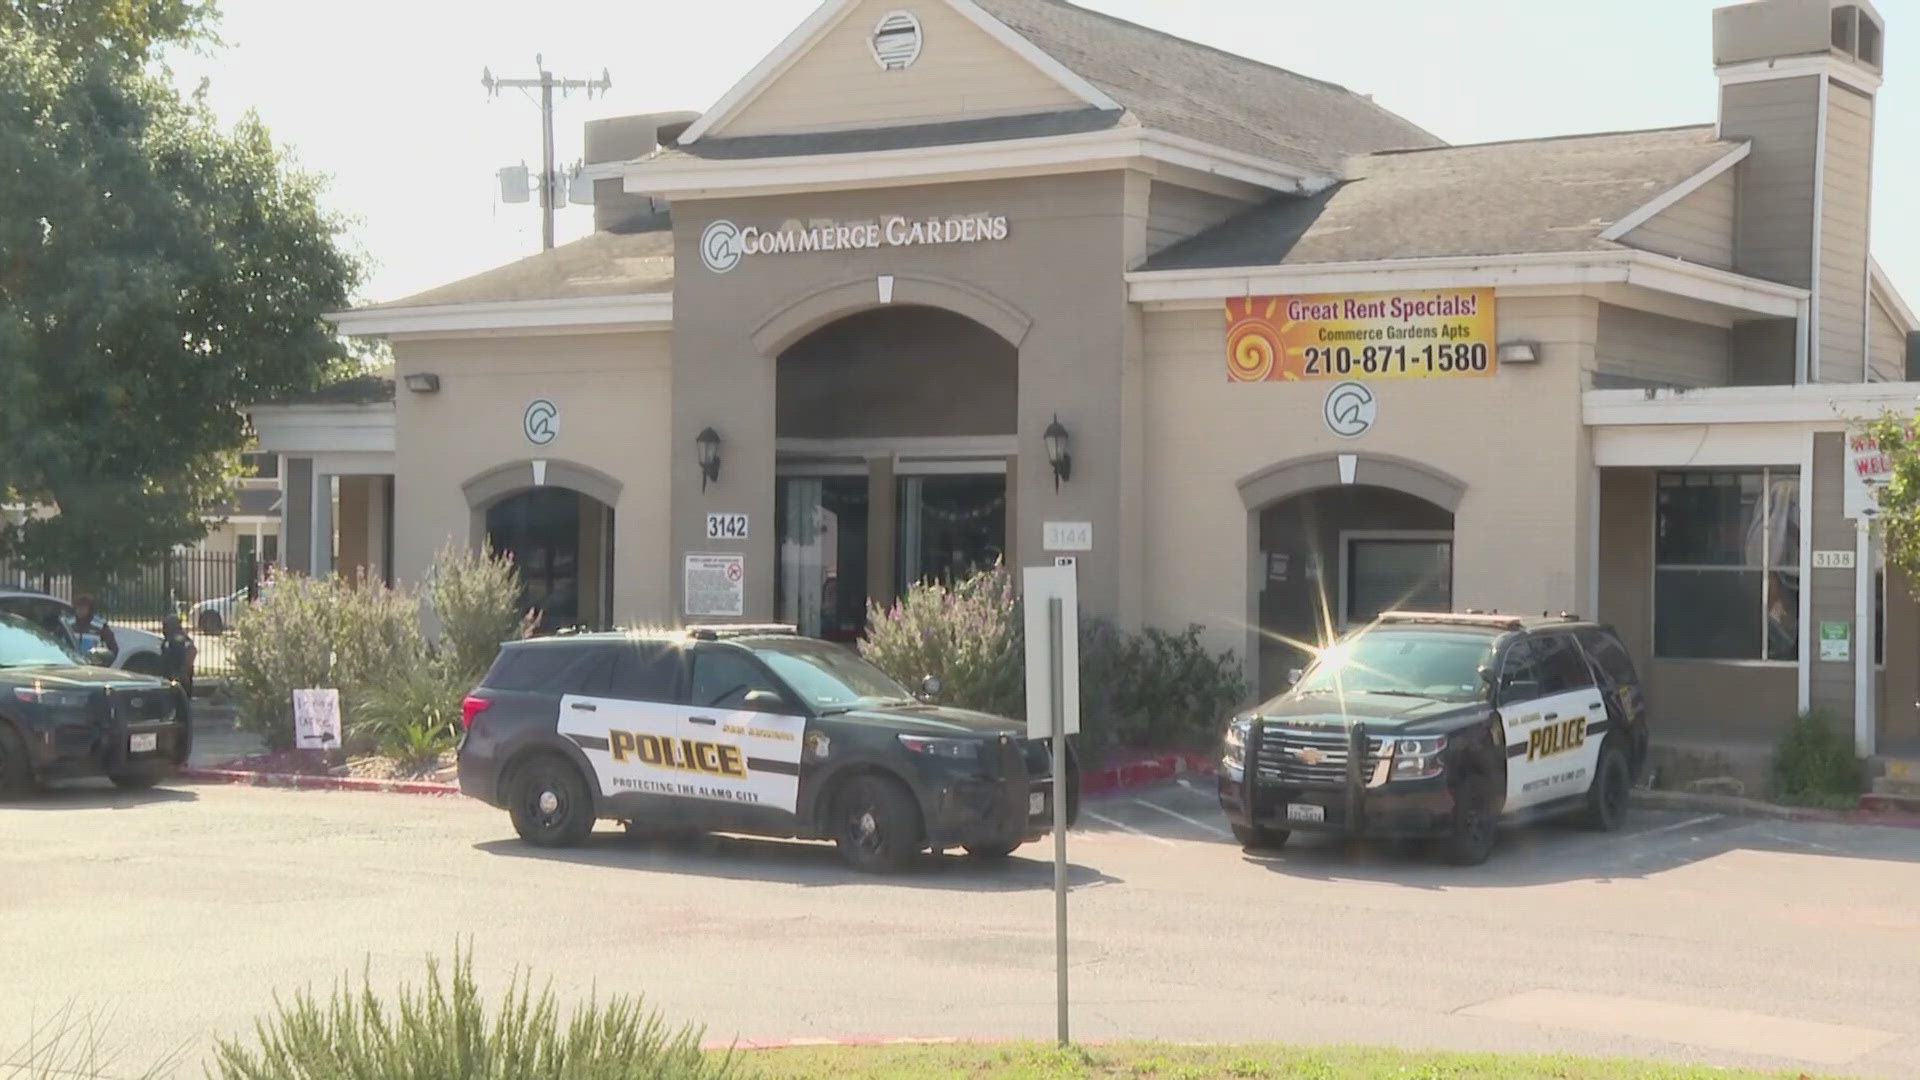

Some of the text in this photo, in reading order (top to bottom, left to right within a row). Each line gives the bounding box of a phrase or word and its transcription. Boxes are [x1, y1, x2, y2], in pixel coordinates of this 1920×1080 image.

[740, 216, 1008, 254] COMMERCE GARDENS
[1288, 294, 1478, 322] Great Rent Specials!
[1318, 323, 1471, 342] Commerce Gardens Apts
[1303, 342, 1489, 375] 210-871-1580
[709, 516, 746, 537] 3142
[1049, 527, 1087, 544] 3144
[1816, 552, 1850, 566] 3138
[1527, 716, 1585, 762] POLICE
[609, 729, 746, 779] POLICE
[612, 776, 760, 803] PROTECTING THE ALAMO CITY
